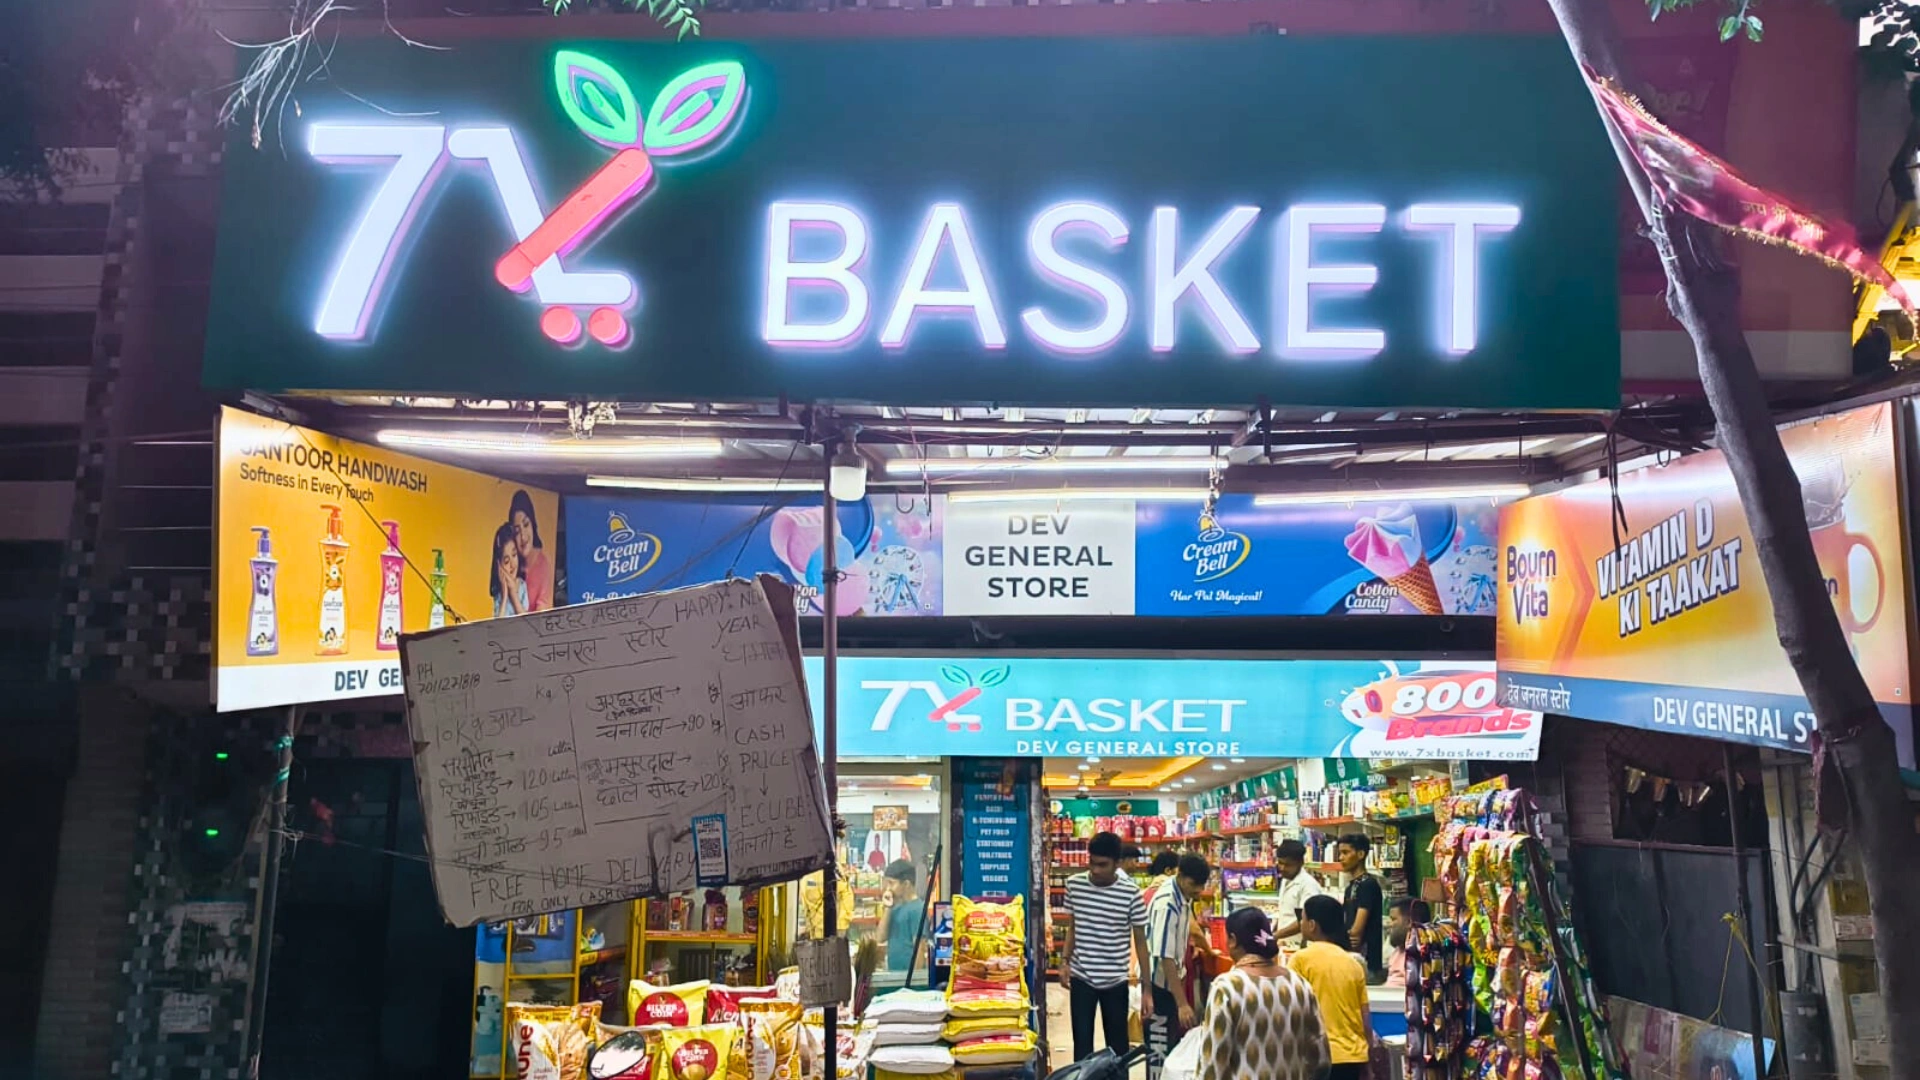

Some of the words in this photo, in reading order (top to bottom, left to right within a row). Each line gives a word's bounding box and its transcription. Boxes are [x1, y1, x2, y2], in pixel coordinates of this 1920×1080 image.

[761, 200, 1522, 358] BASKET
[240, 463, 295, 488] Softness
[298, 474, 308, 490] in
[311, 478, 343, 500] Every
[345, 484, 374, 502] Touch
[338, 454, 428, 492] HANDWASH
[1008, 515, 1070, 535] DEV
[593, 539, 649, 563] Cream
[965, 546, 1113, 567] GENERAL
[1183, 538, 1238, 561] Cream
[1596, 509, 1687, 600] VITAMIN
[1695, 499, 1716, 549] D
[608, 554, 639, 578] Bell
[1195, 553, 1229, 576] Bell
[988, 577, 1090, 598] STORE
[1356, 582, 1399, 597] Cotton
[1619, 590, 1641, 637] KI
[1646, 537, 1742, 626] TAAKAT
[1345, 593, 1391, 612] Candy
[488, 640, 528, 674] देव
[335, 670, 369, 692] DEV
[1391, 678, 1496, 715] 800
[1507, 677, 1520, 703] देव
[1521, 685, 1549, 707] जनरल
[1550, 682, 1572, 710] स्टोर
[1005, 698, 1247, 732] BASKET
[1386, 708, 1533, 741] Brands
[1653, 696, 1689, 726] DEV
[1693, 701, 1789, 741] GENERAL
[734, 725, 786, 746] CASH
[1017, 740, 1058, 754] DEV
[1065, 741, 1168, 755] GENERAL
[1174, 742, 1240, 756] STORE
[1370, 748, 1530, 759] www.7xbasket.com
[471, 874, 525, 909] FREE
